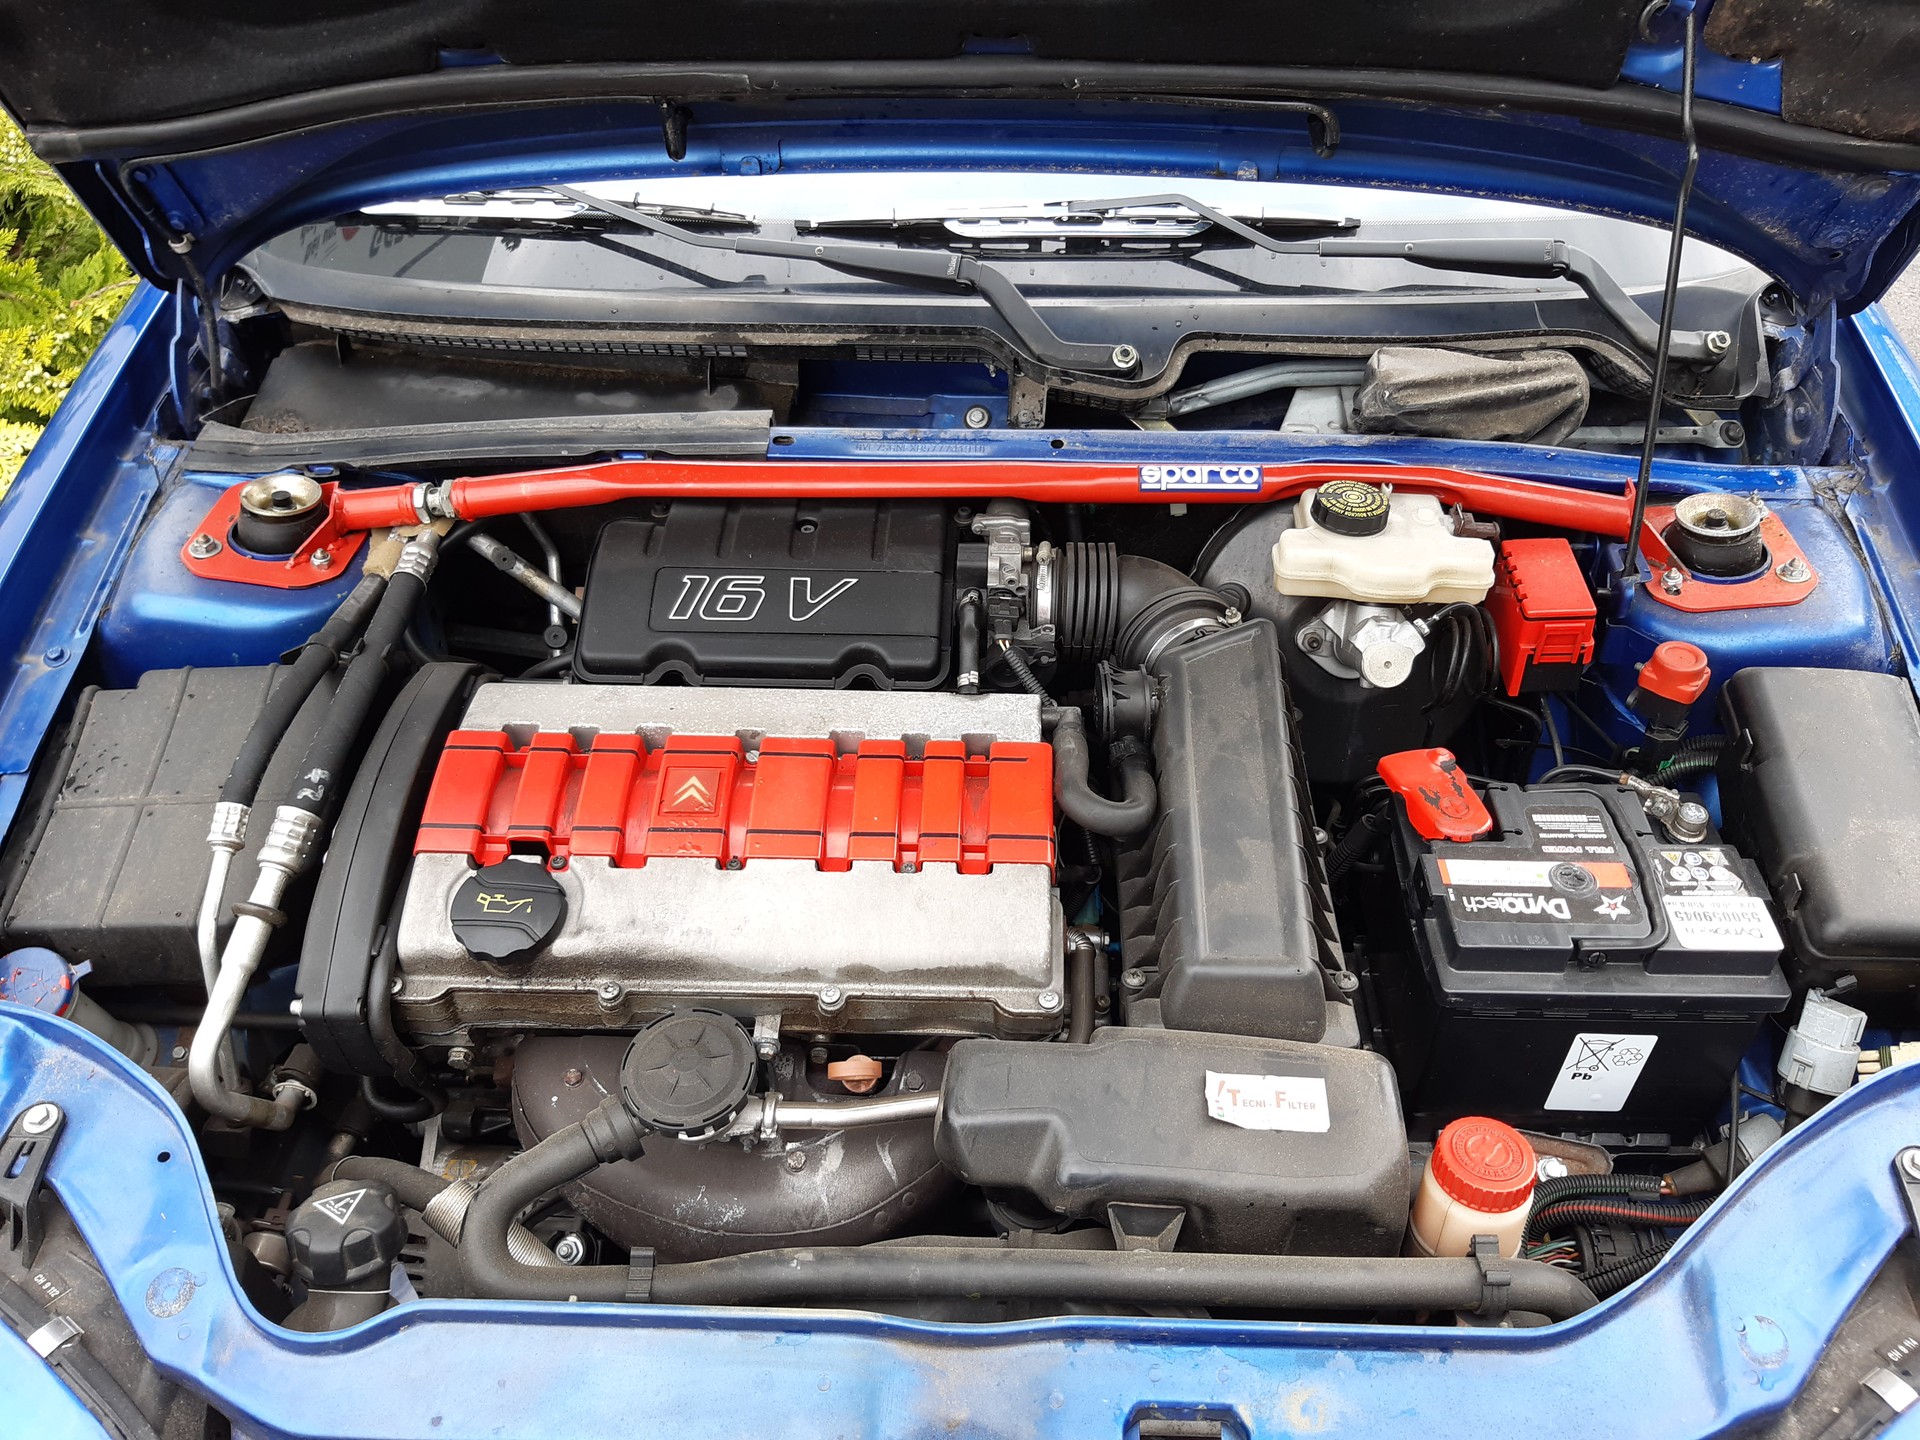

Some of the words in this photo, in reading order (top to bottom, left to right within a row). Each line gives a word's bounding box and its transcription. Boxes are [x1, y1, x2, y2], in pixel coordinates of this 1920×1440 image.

[1141, 465, 1259, 490] sparco
[669, 575, 766, 621] 16
[789, 576, 859, 622] V
[1541, 845, 1584, 853] POWER
[1570, 1072, 1593, 1081] Pb
[1226, 1088, 1267, 1108] TECNI
[1275, 1090, 1317, 1110] FILTER
[34, 1274, 47, 1285] CH
